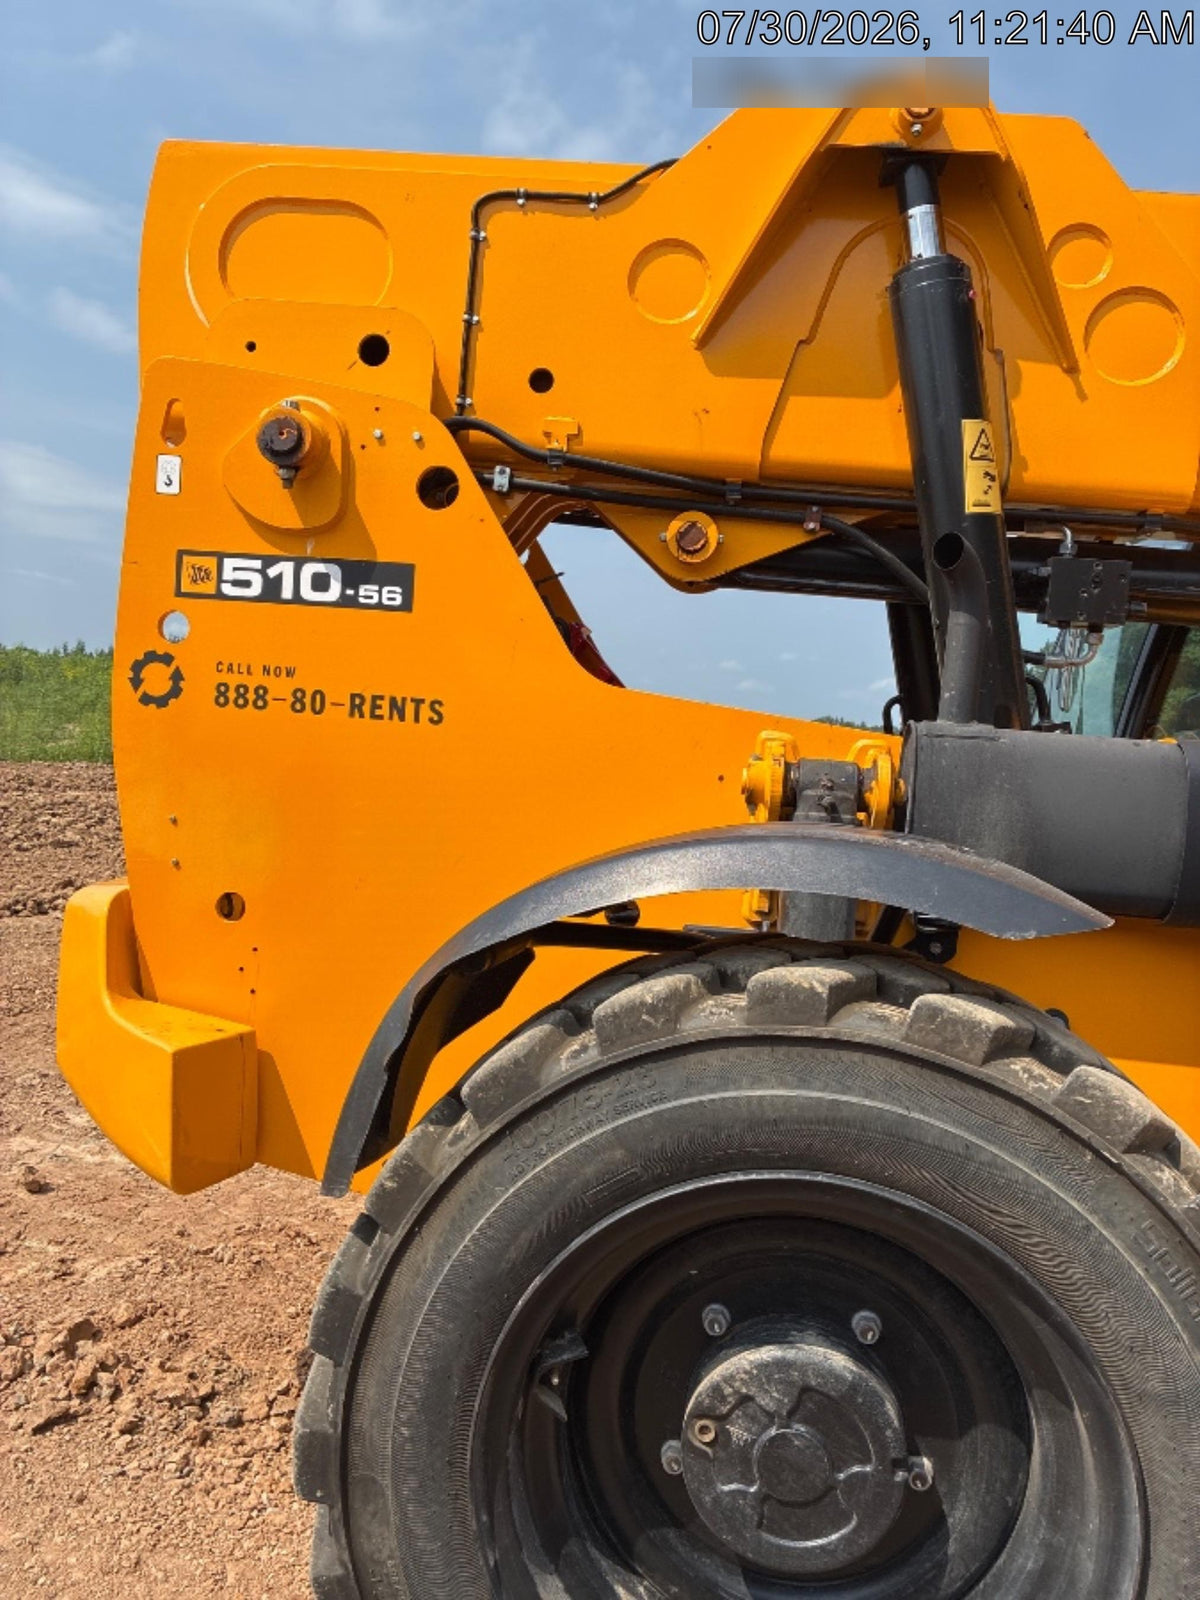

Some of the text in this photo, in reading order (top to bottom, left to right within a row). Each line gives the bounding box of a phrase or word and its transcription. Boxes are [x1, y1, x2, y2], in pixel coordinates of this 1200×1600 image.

[220, 557, 403, 606] 510-56
[215, 660, 297, 679] CALL NOW
[213, 681, 445, 726] 888-80-RENTS
